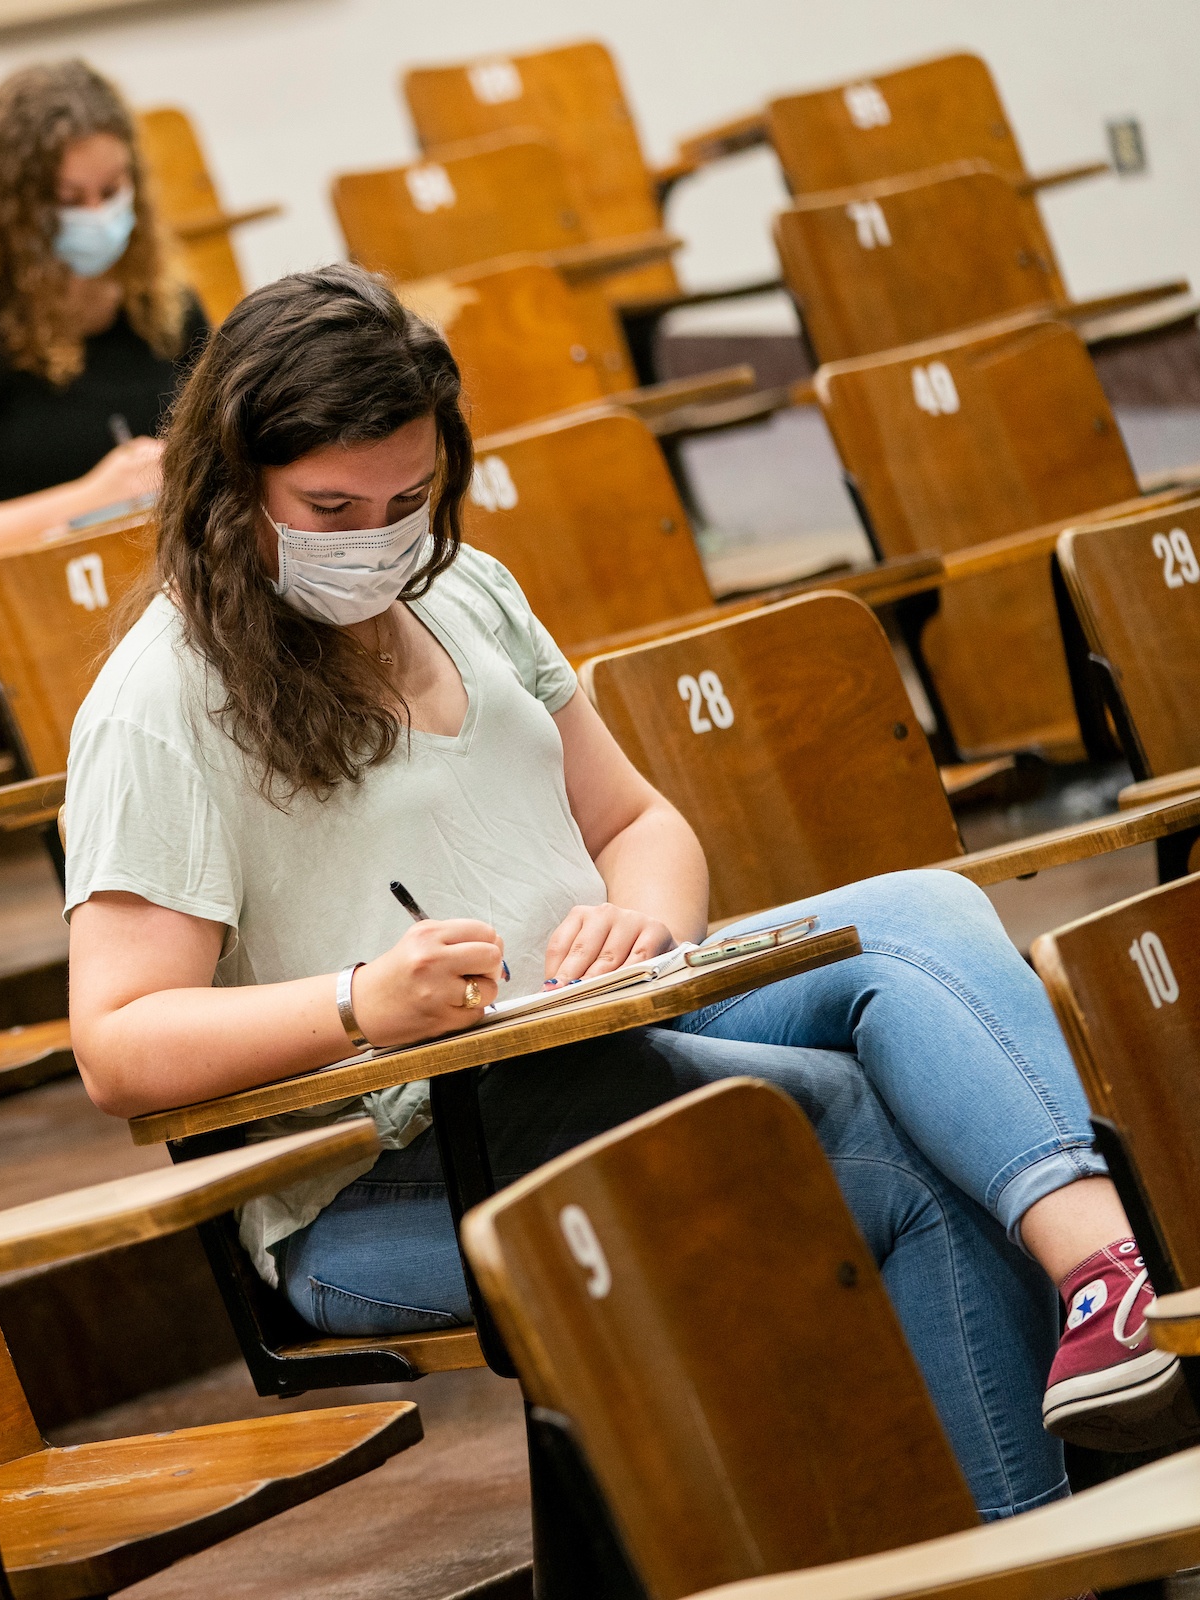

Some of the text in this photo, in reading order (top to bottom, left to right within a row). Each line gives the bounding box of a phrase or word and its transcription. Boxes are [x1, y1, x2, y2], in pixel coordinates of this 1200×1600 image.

[849, 201, 890, 247] 71
[913, 364, 958, 413] 49
[67, 554, 108, 610] 47
[1152, 530, 1200, 587] 29
[677, 671, 734, 733] 28
[1130, 932, 1178, 1007] 10
[562, 1207, 609, 1295] 9
